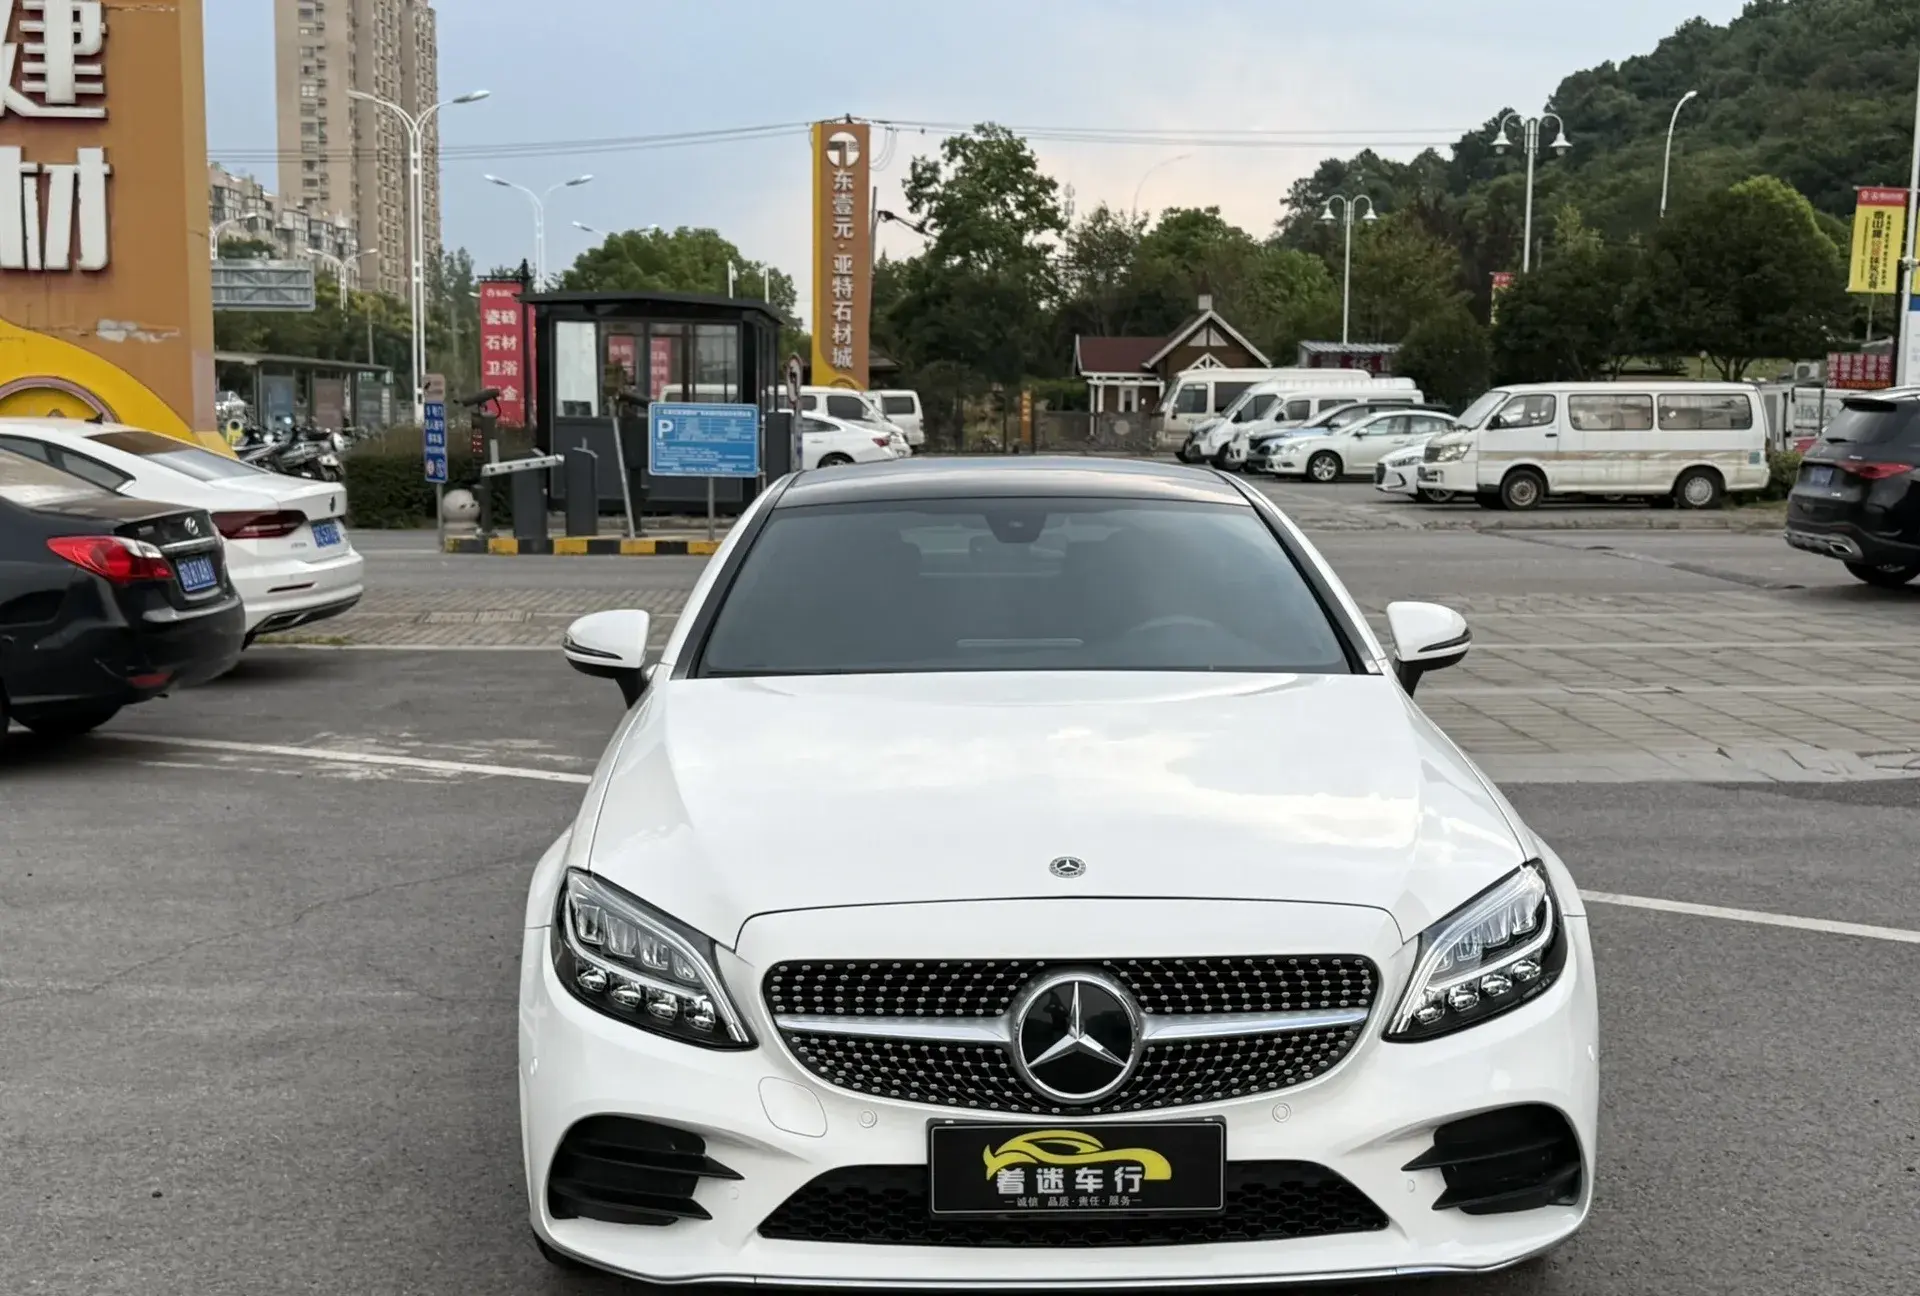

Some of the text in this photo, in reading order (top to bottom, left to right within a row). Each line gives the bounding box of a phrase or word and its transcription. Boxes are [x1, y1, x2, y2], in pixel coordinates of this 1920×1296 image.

[485, 309, 517, 326] 瓷砖
[485, 335, 518, 351] 石材
[486, 360, 518, 377] 卫浴
[657, 419, 674, 440] P
